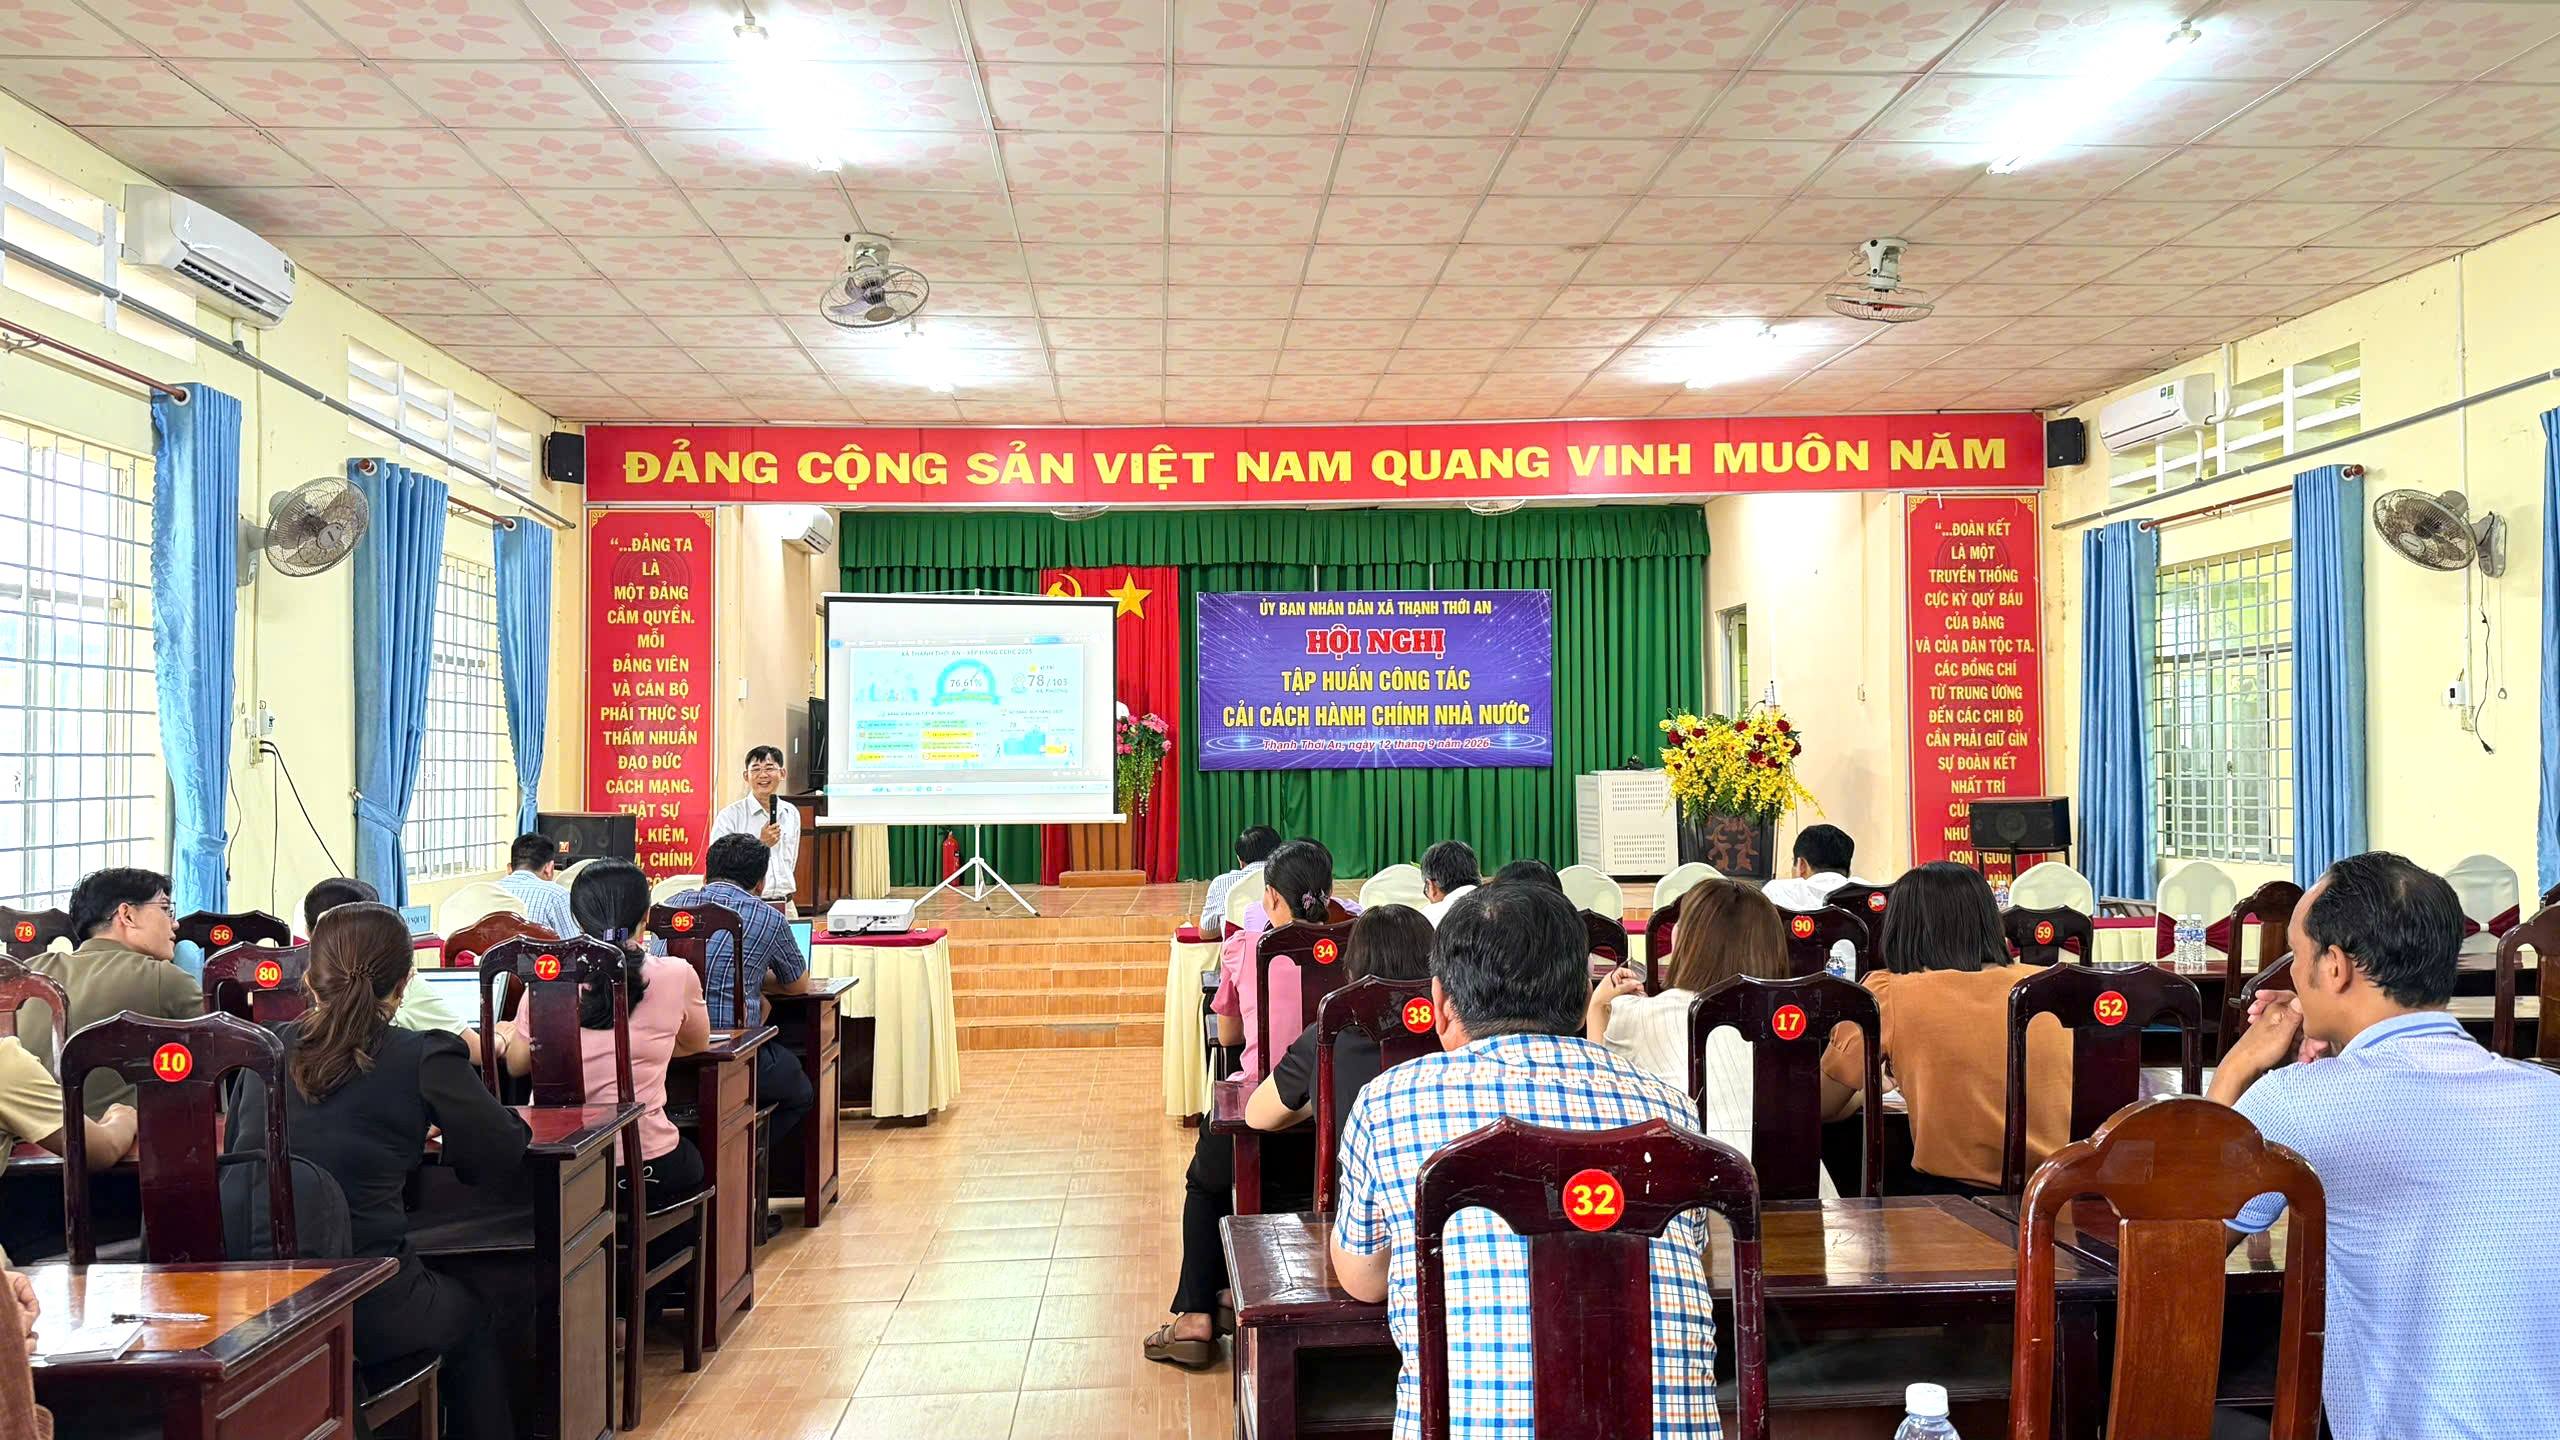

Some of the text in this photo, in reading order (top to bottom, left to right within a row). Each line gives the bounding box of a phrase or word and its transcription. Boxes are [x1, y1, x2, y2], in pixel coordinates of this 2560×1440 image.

[623, 432, 2006, 491] ĐẢNG CỘNG SẢN VIỆT NAM QUANG VINH MUÔN NĂM
[1987, 517, 2011, 536] KẾT
[674, 537, 693, 552] TA
[1951, 542, 1996, 562] LÀ MỘT
[642, 558, 660, 576] LÀ
[1978, 564, 2019, 583] THỐNG
[614, 581, 689, 603] MỘT ĐẢNG
[1924, 589, 2023, 609] CỰC KỲ QUÝ BÁU
[607, 604, 695, 627] CẦM QUYỀN.
[1259, 598, 1492, 618] ỦY BAN NHÂN DÂN XÃ THẠNH THỚI AN
[1945, 610, 2005, 630] CỦA ĐẢNG
[637, 627, 665, 648] MỖI
[1306, 624, 1446, 660] HỘI NGHỊ
[1915, 634, 2035, 655] VÀ CỦA DÂN TỘC TA.
[612, 653, 689, 673] ĐẢNG VIÊN
[1934, 660, 1959, 677] CÁC
[1996, 659, 2017, 676] CHÍ
[612, 678, 689, 699] VÀ CÁN BỘ
[1027, 674, 1045, 687] 78
[1281, 664, 1471, 695] TẬP HUẤN CÔNG TÁC
[1929, 683, 2023, 700] TỪ TRUNG ƯƠNG
[600, 701, 701, 724] PHẢI THỰC SỰ
[1222, 700, 1530, 728] CẢI CÁCH HÀNH CHÍNH NHÀ NƯỚC
[1928, 704, 2024, 726] ĐẾN CÁC CHI BỘ
[603, 725, 698, 745] THẤM NHUẦN
[1263, 740, 1297, 753] Thạnh
[1326, 740, 1346, 752] An,
[1348, 741, 1376, 753] ngày
[1379, 739, 1392, 750] 12
[1394, 738, 1425, 752] tháng
[1427, 738, 1435, 750] 9
[1438, 737, 1461, 749] năm
[1463, 737, 1490, 749] 2026
[1925, 727, 2028, 747] CẦN PHẢI GIỮ GÌN
[618, 752, 682, 774] ĐẠO ĐỨC
[1937, 751, 2017, 773] SỰ ĐOÀN KẾT
[605, 776, 694, 796] CÁCH MẠNG.
[1951, 775, 2006, 794] NHẤT TRÍ
[660, 801, 681, 821] SỰ
[648, 824, 689, 845] KIỆM,
[1944, 825, 1970, 841] NHƯ
[649, 848, 693, 867] CHÍNH
[1949, 851, 1973, 865] CON
[16, 925, 33, 938] 78
[674, 915, 691, 928] 95
[1794, 919, 1812, 933] 90
[213, 929, 230, 941] 56
[2036, 926, 2052, 939] 59
[1316, 944, 1334, 958] 34
[258, 967, 278, 981] 80
[537, 959, 557, 975] 72
[1406, 1006, 1432, 1025] 38
[2099, 998, 2123, 1018] 52
[1777, 1013, 1800, 1031] 17
[159, 1052, 186, 1072] 10
[1572, 1185, 1617, 1216] 32
